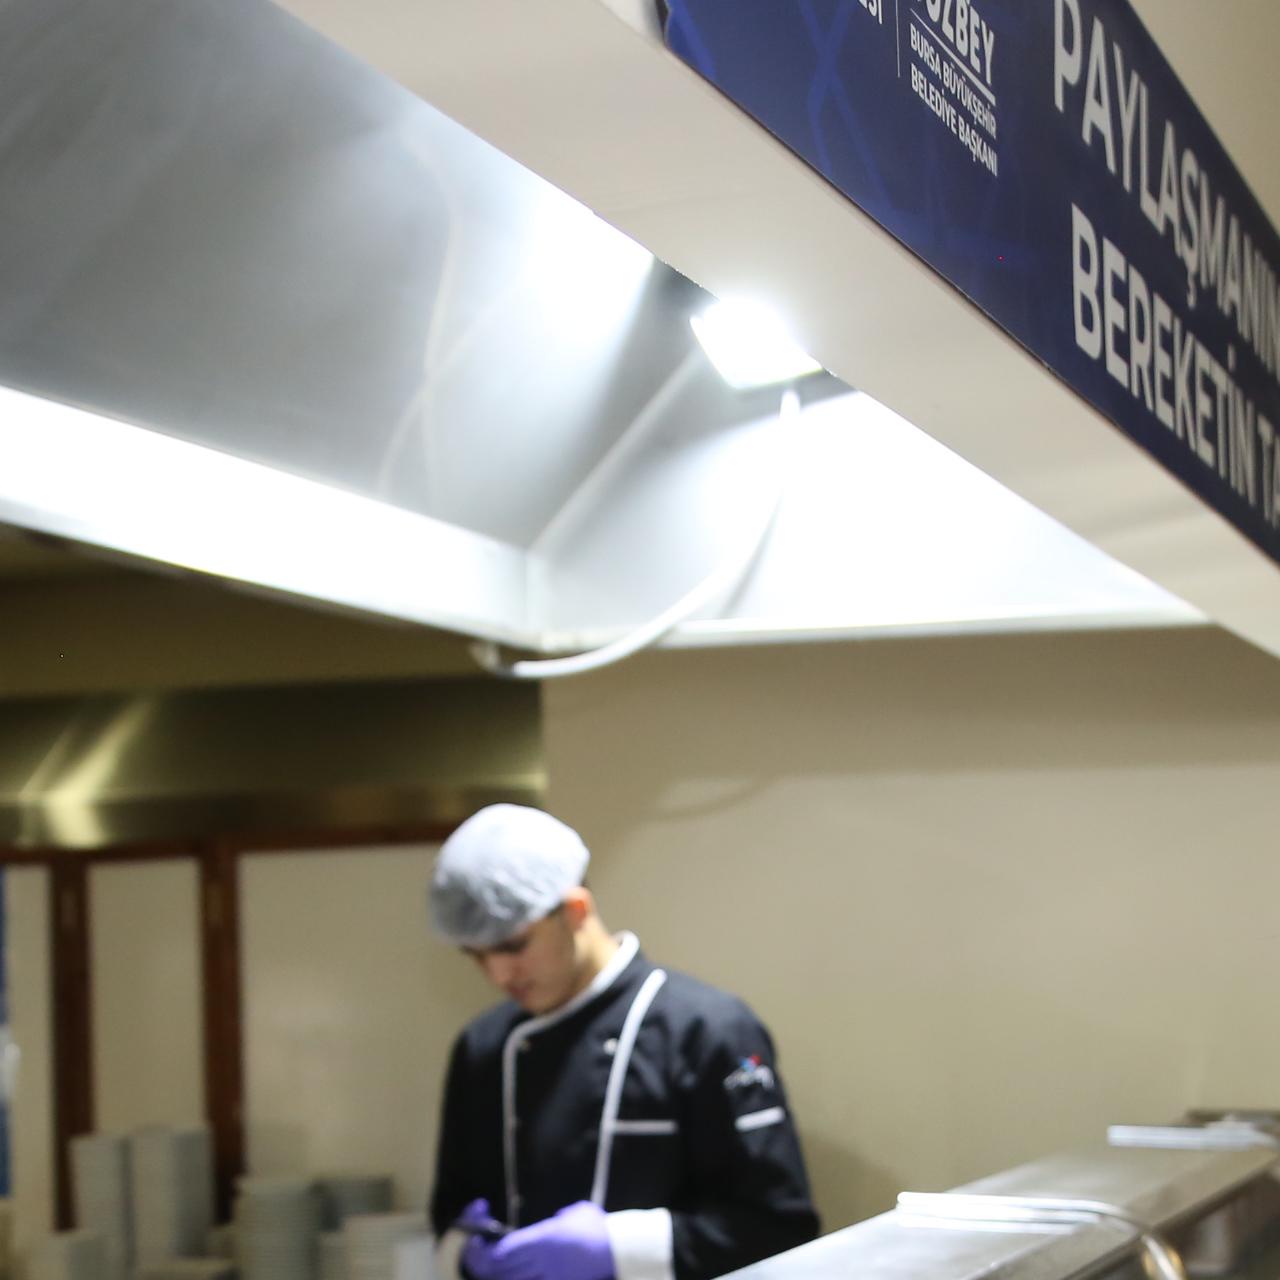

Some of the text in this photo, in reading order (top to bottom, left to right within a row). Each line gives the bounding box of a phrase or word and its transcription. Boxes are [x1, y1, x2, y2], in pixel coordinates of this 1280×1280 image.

[910, 22, 996, 140] BURSA BÜYÜKŞEHİR
[911, 62, 998, 177] BELEDİYE BAŞKANI
[1071, 202, 1256, 508] BEREKETİN
